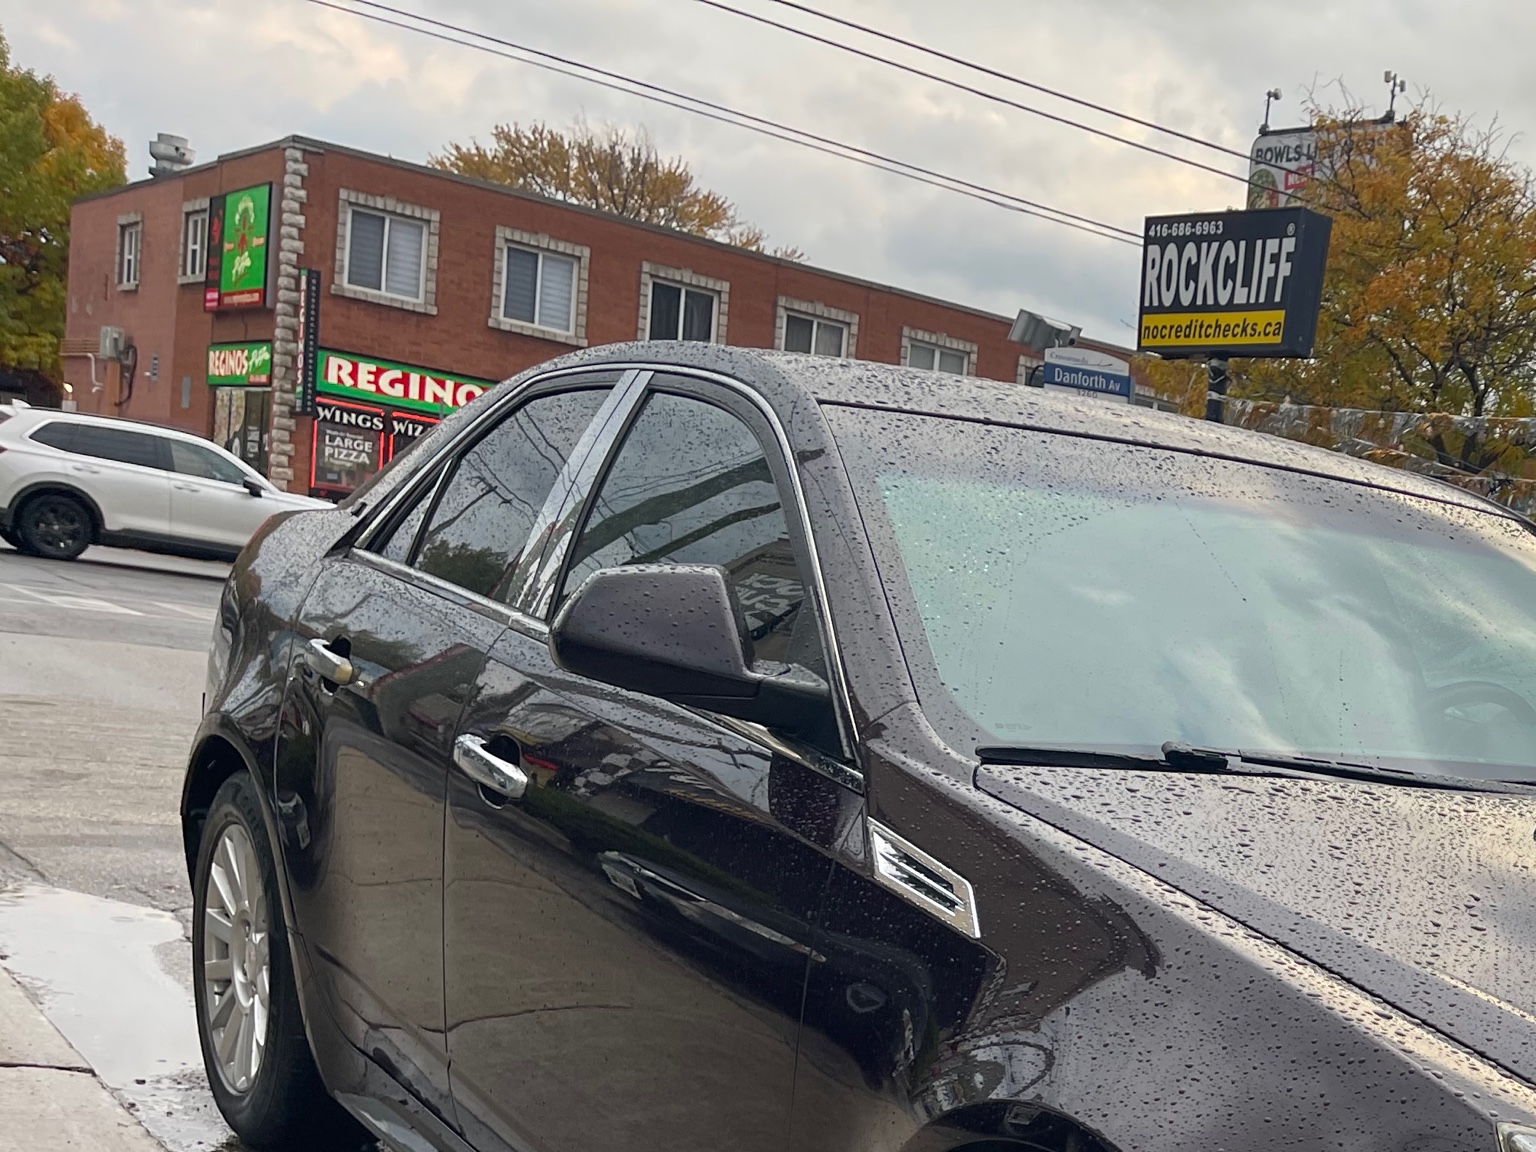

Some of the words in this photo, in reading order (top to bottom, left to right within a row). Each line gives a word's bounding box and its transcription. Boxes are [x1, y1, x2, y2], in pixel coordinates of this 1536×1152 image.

[1255, 144, 1302, 165] BOWLS
[1149, 220, 1224, 237] 416-686-6963
[1144, 237, 1296, 307] ROCKCLIFF
[1143, 318, 1282, 340] nocreditchecks.ca
[208, 348, 249, 377] REGINOS
[327, 356, 484, 408] REGINO
[1054, 367, 1106, 389] Danforth
[1108, 379, 1121, 392] Av
[317, 406, 384, 431] WINGS
[392, 420, 431, 437] WIZ
[325, 434, 373, 453] LARGE
[325, 446, 370, 465] PIZZA
